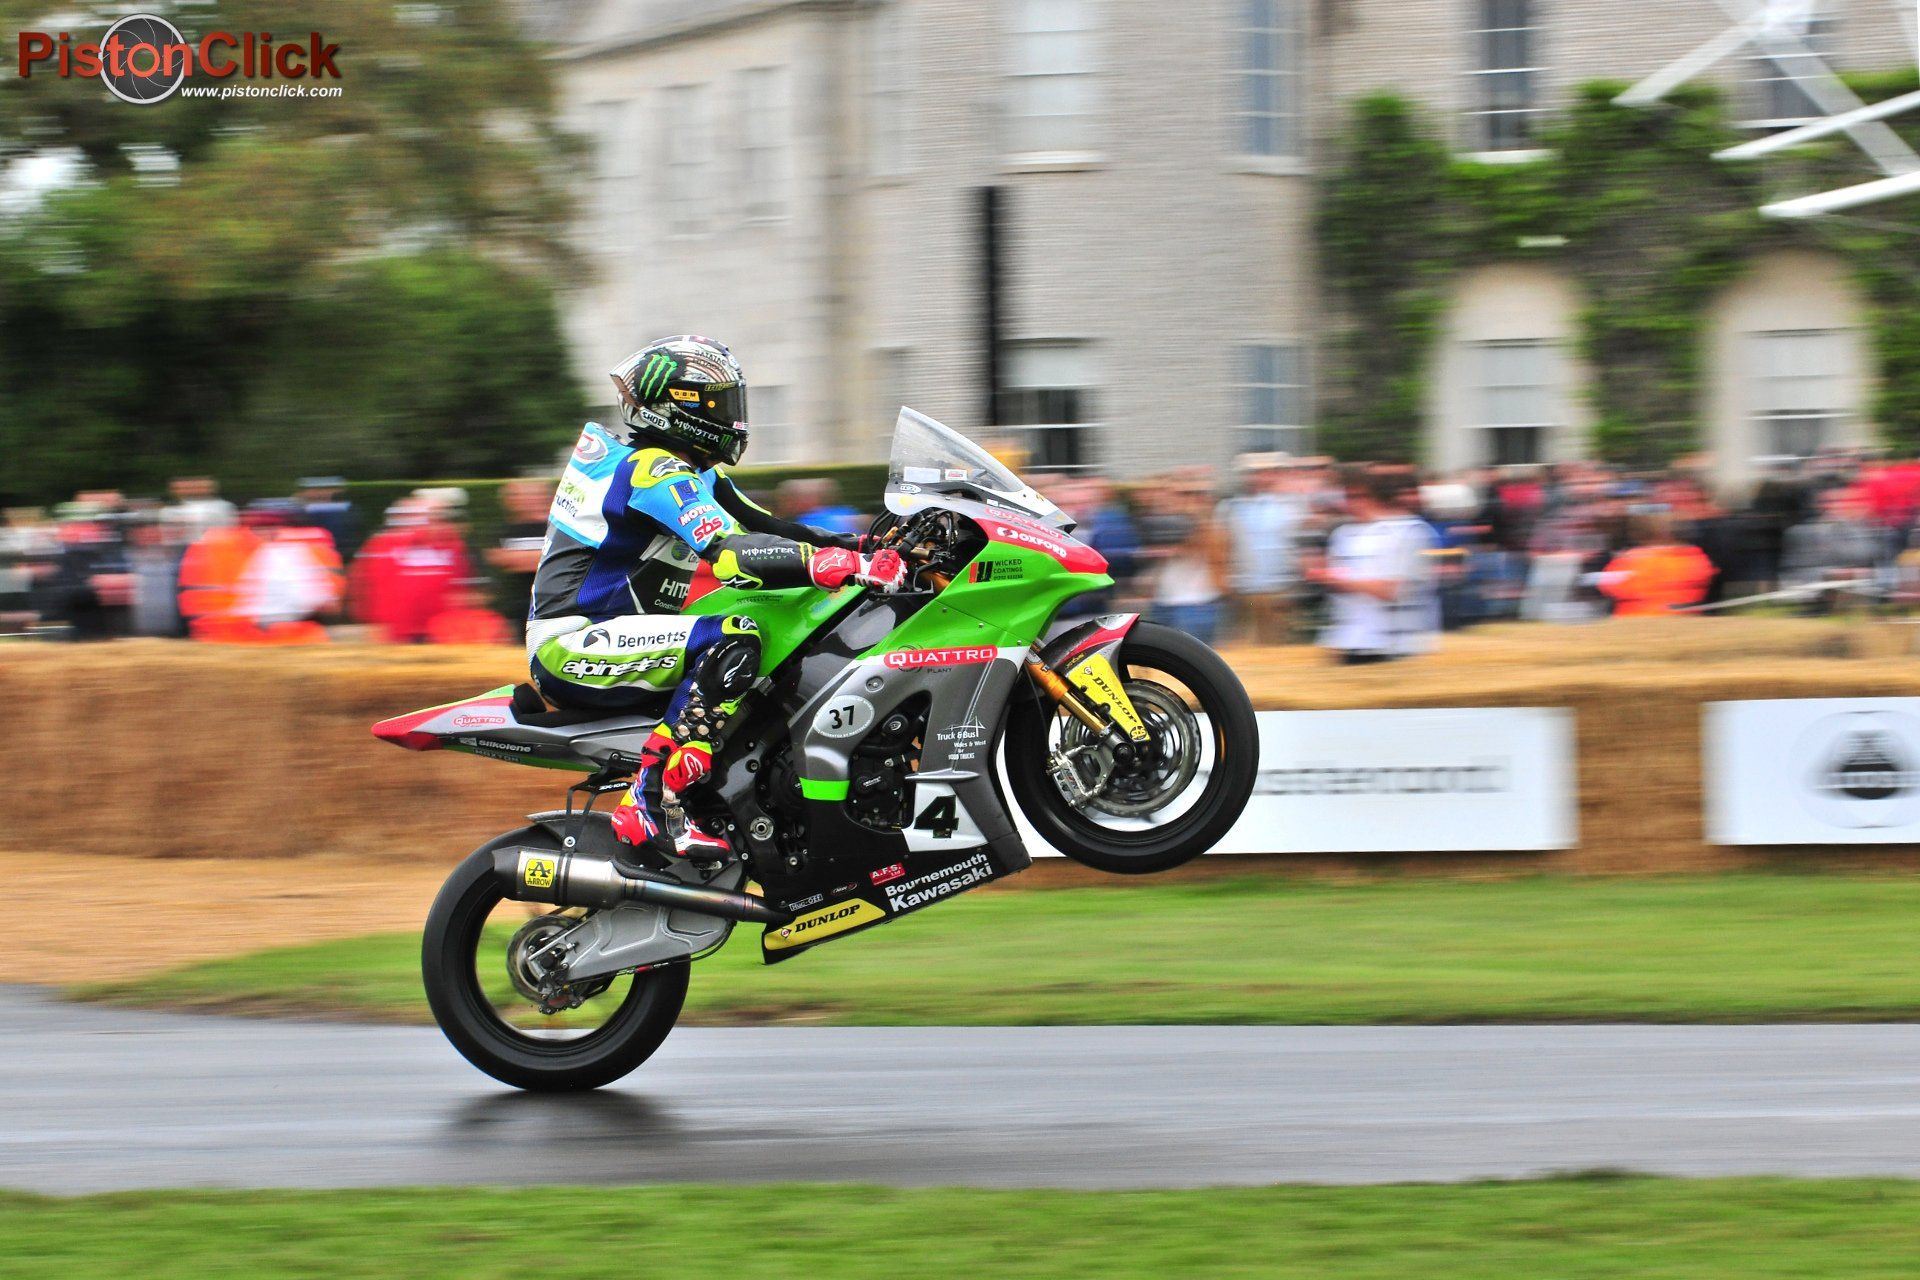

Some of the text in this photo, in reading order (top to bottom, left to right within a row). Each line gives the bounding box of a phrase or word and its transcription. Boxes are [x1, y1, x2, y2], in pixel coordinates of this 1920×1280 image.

[674, 418, 719, 442] MONSTER
[694, 517, 722, 542] sbs
[741, 547, 795, 556] MONSTER
[1019, 533, 1067, 558] OXFORD
[617, 631, 687, 648] Bennetts
[562, 655, 678, 678] alpinestars
[889, 648, 993, 667] QUATTRO
[1092, 676, 1138, 724] DUNLOP
[456, 717, 503, 726] QUATTRO
[828, 704, 855, 730] 37
[479, 740, 531, 752] Silkolene
[937, 730, 976, 740] Truck & Bus
[914, 795, 960, 839] 4
[527, 877, 551, 887] ARROW
[884, 853, 987, 898] Bournemouth
[889, 862, 994, 912] Kawasaki
[795, 904, 861, 933] DUNLOP
